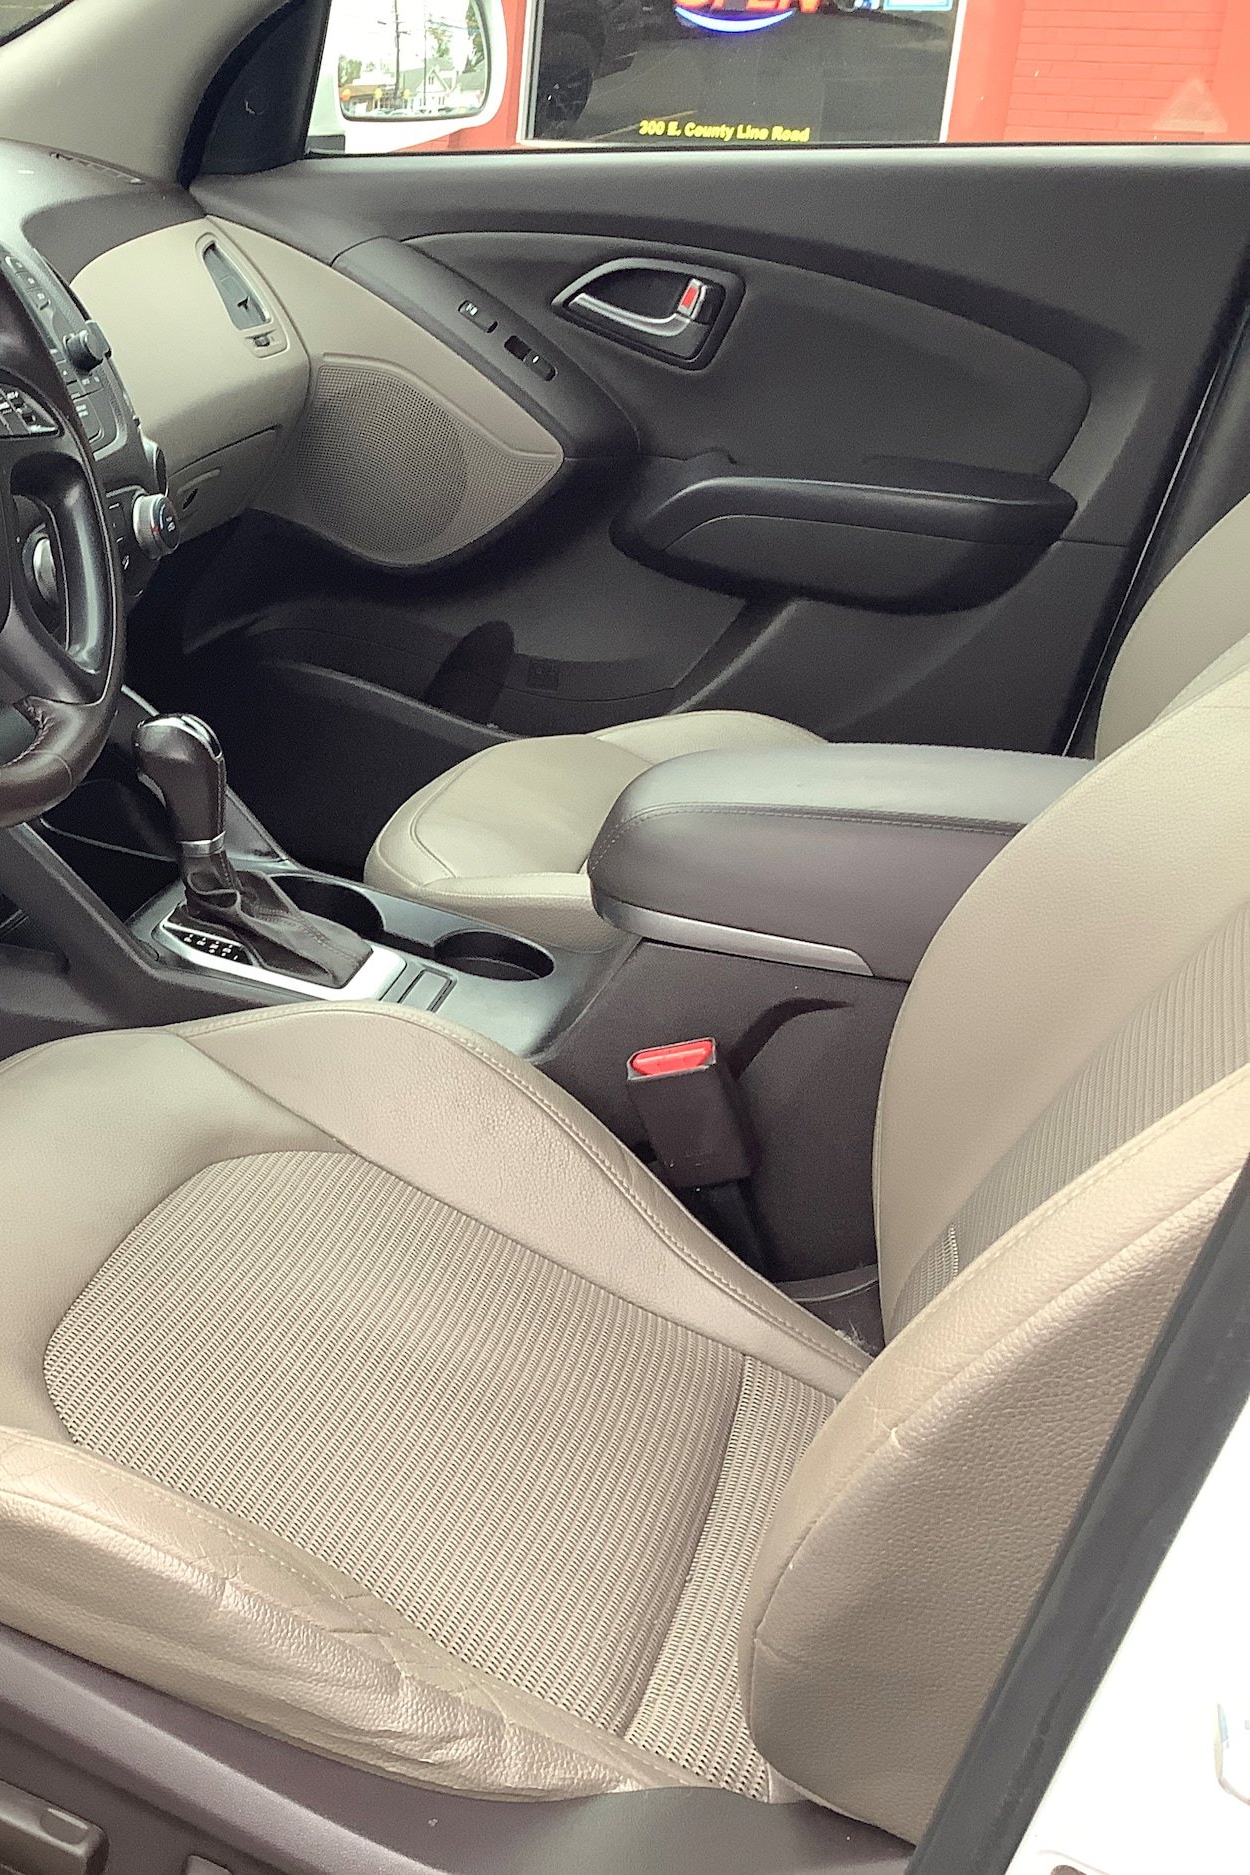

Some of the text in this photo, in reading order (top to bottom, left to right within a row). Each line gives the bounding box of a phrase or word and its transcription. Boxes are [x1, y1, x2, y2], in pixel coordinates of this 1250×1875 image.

[684, 121, 735, 142] County
[736, 124, 769, 140] Line
[771, 125, 810, 142] Road
